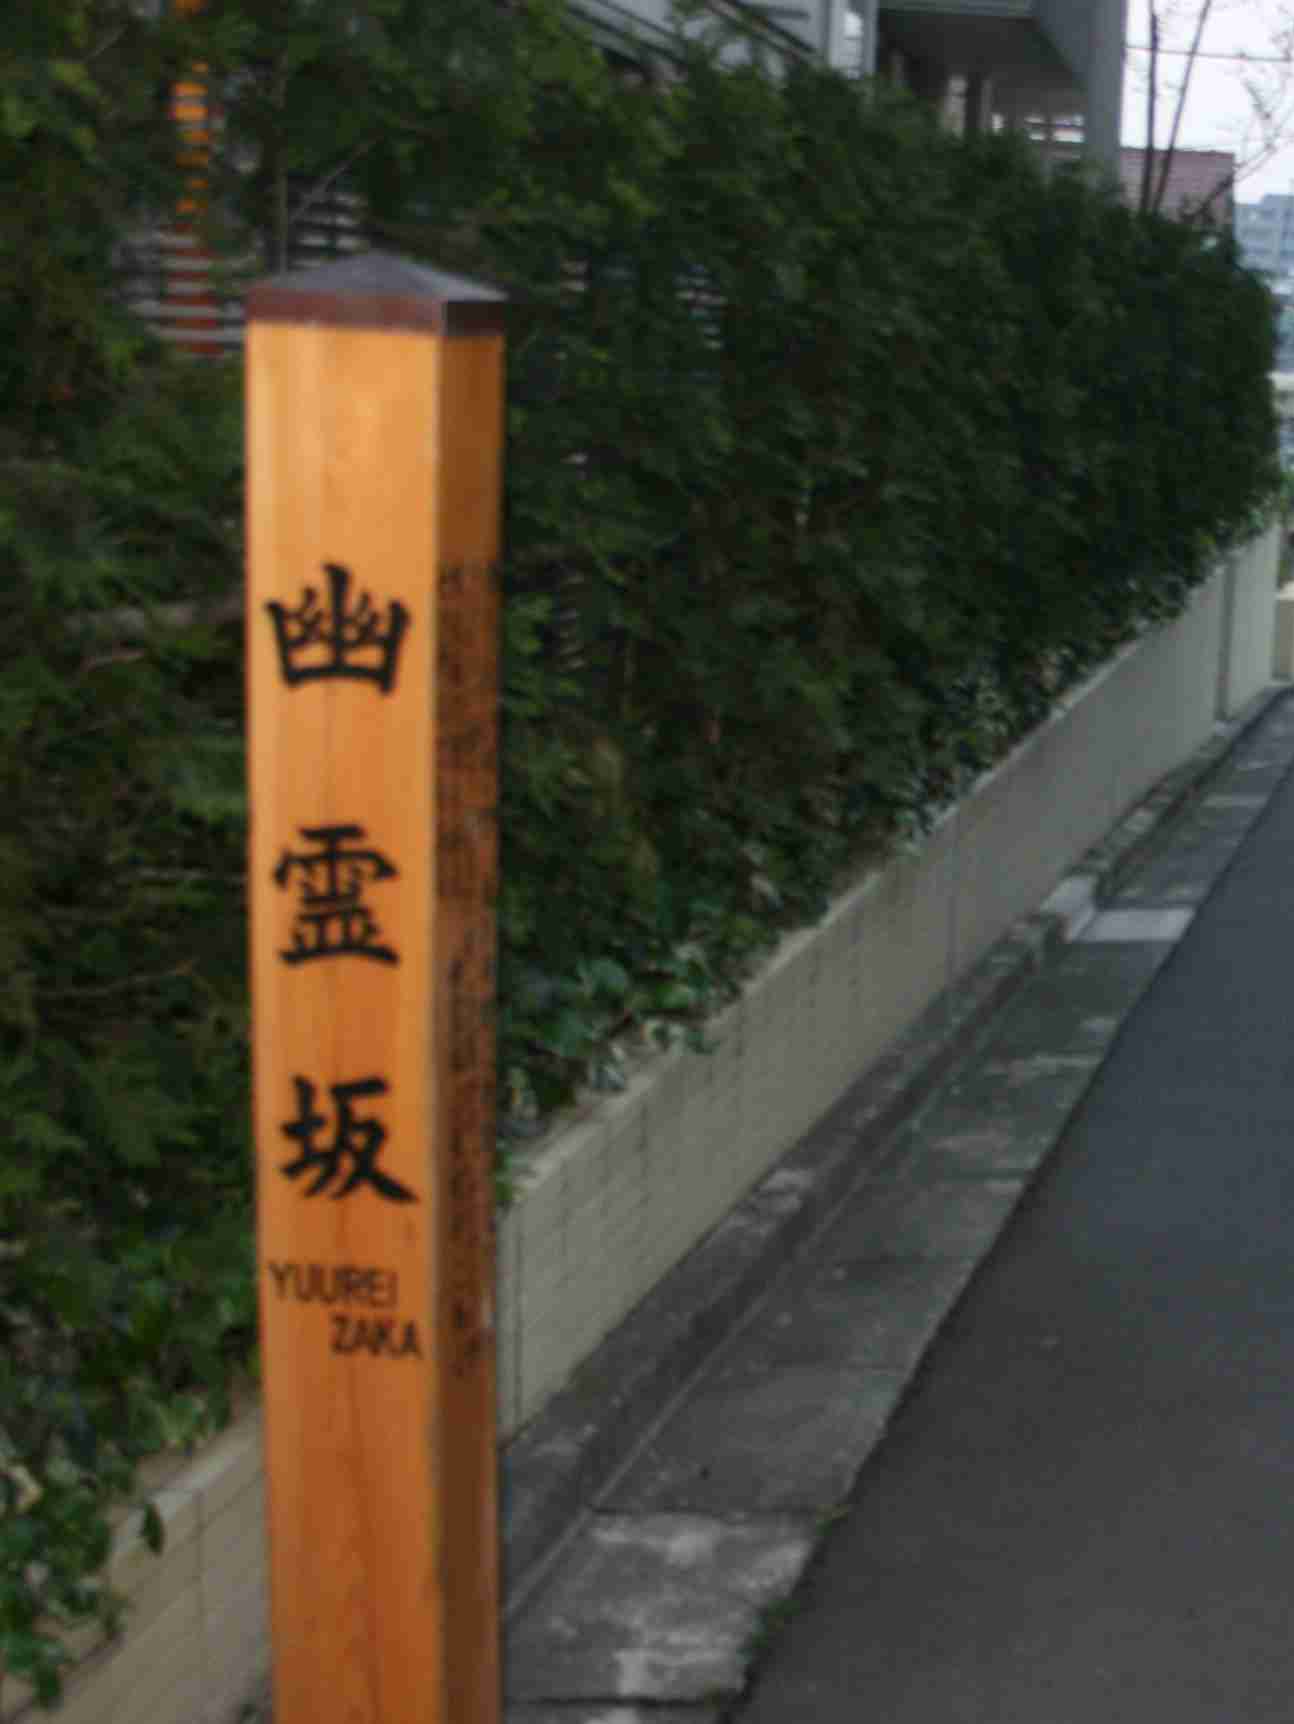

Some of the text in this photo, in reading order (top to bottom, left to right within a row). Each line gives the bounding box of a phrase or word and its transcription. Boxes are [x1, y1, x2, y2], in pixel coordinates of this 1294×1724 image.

[265, 563, 418, 1202] 幽霊坂
[267, 1261, 399, 1309] YUUREI
[331, 1313, 424, 1360] ZAKA
